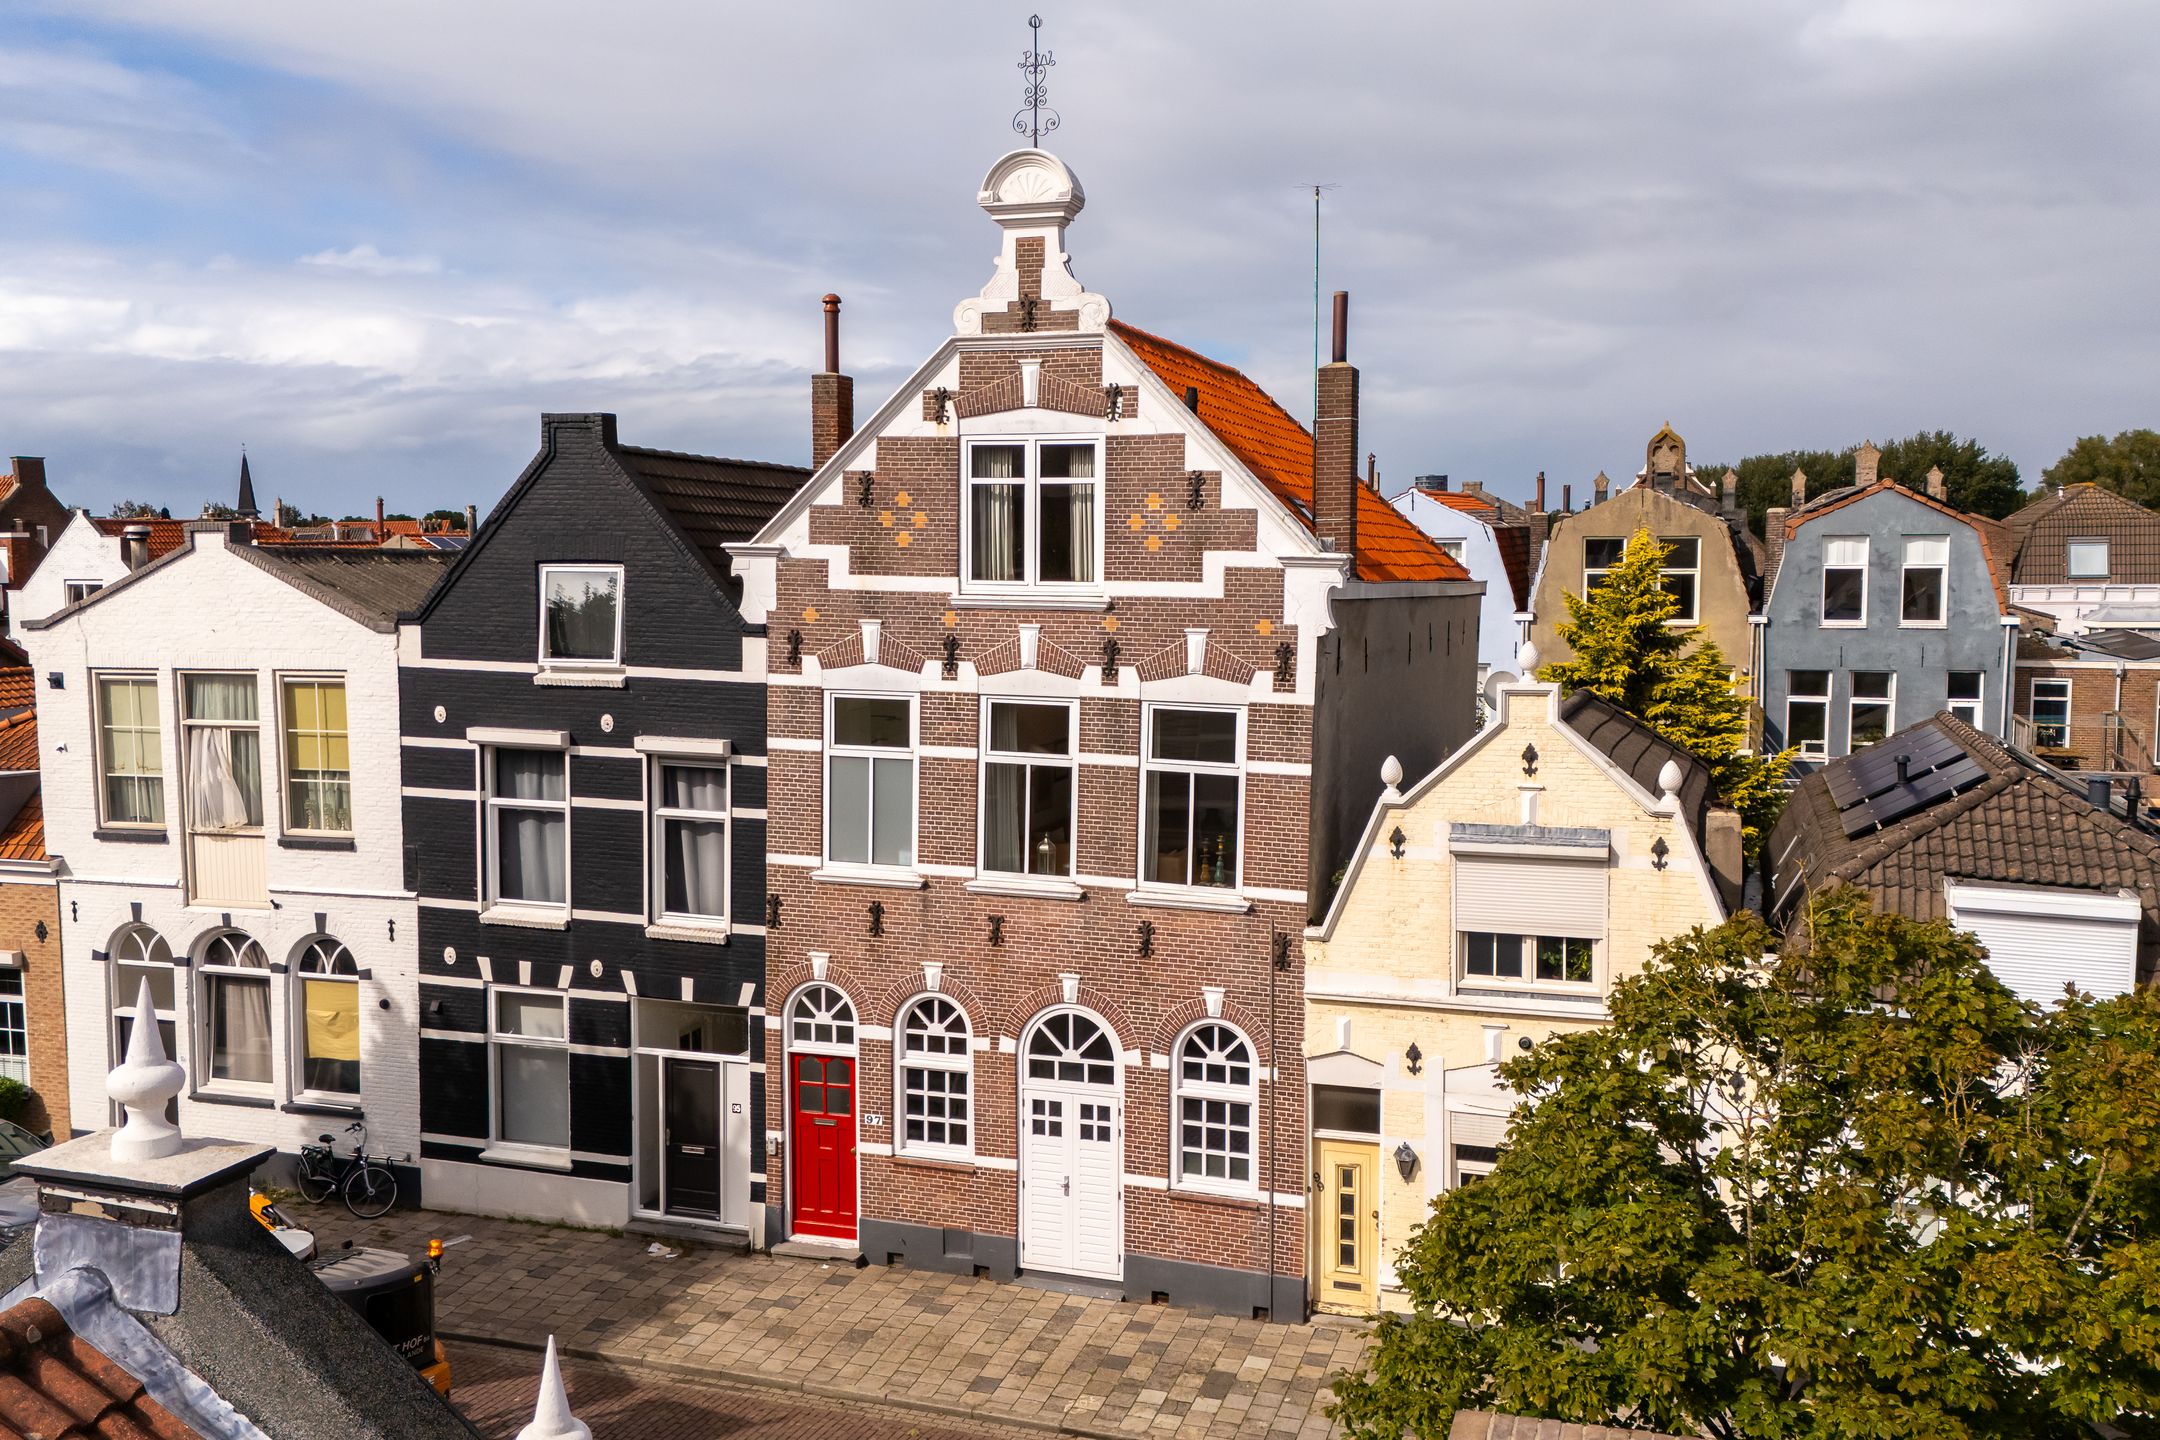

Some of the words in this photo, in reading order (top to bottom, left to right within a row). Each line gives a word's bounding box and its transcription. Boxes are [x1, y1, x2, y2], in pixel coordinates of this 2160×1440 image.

[866, 1115, 881, 1125] 97
[1313, 1171, 1325, 1192] 99
[402, 1335, 423, 1352] HOF
